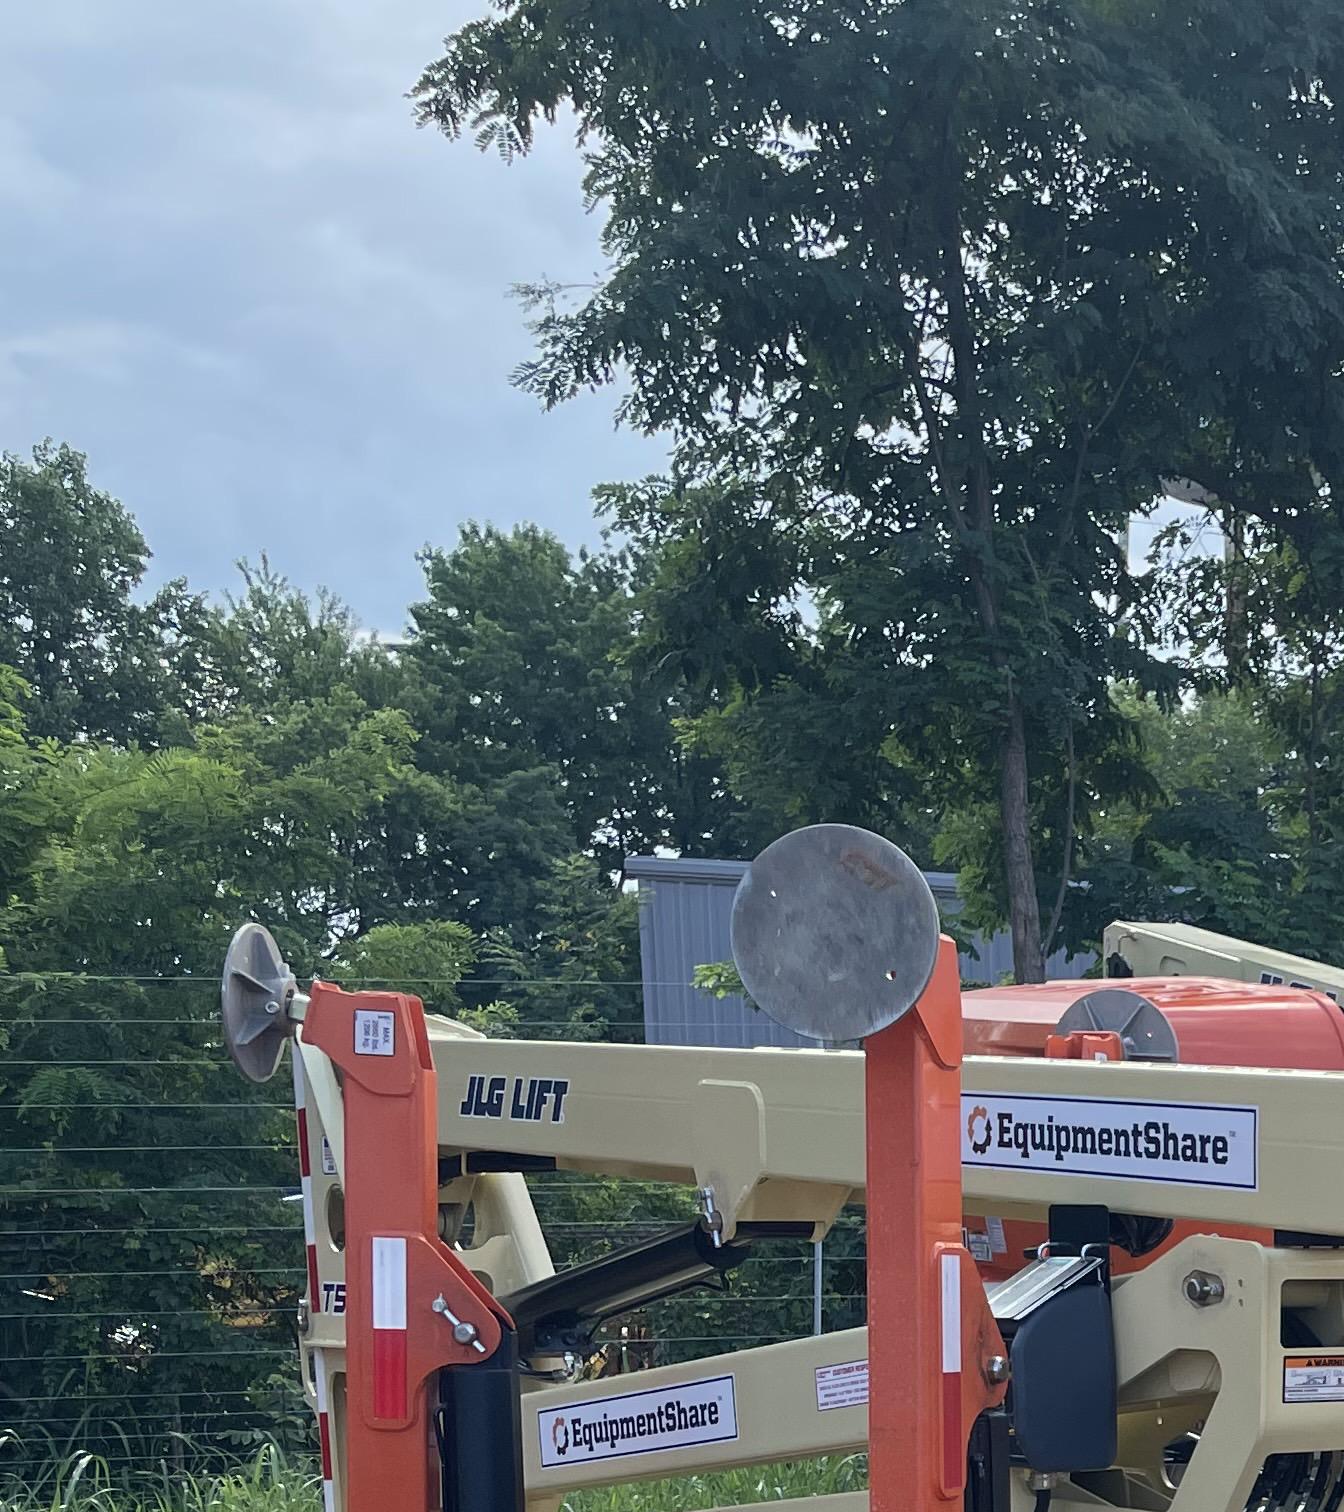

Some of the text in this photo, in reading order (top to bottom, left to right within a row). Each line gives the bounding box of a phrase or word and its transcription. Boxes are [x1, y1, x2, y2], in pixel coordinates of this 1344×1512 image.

[461, 1076, 569, 1122] JLG LIFT
[997, 1113, 1229, 1165] EquipmentShare
[571, 1400, 718, 1451] EquipmentShare
